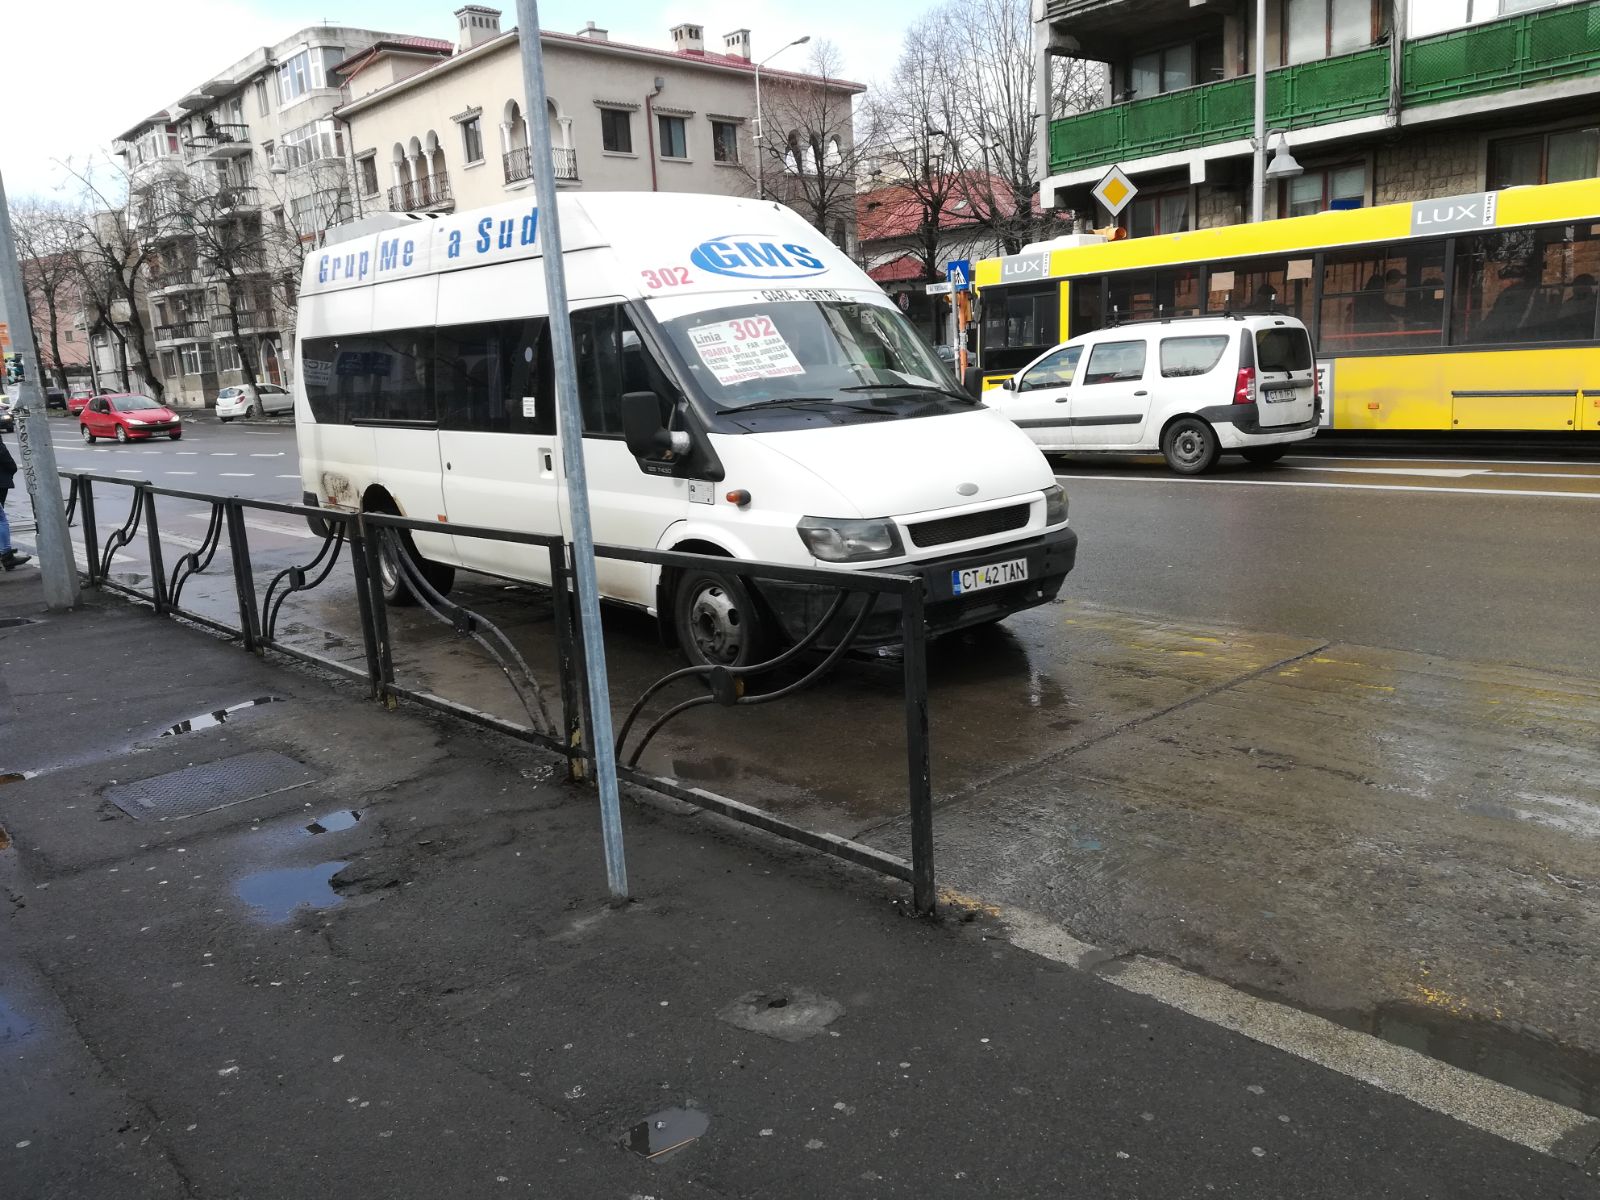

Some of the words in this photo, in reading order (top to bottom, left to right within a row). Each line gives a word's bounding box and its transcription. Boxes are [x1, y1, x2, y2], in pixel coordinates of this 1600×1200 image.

[1416, 203, 1478, 225] LUX
[319, 249, 369, 284] Grup
[475, 206, 540, 254] Sud
[698, 241, 825, 270] GMS
[641, 266, 694, 290] 302
[1004, 260, 1040, 275] LUX
[761, 289, 796, 302] GARA
[693, 331, 722, 344] Linia
[729, 317, 777, 341] 302
[962, 570, 979, 590] CT
[984, 566, 999, 585] 42
[1001, 561, 1025, 581] TAN
